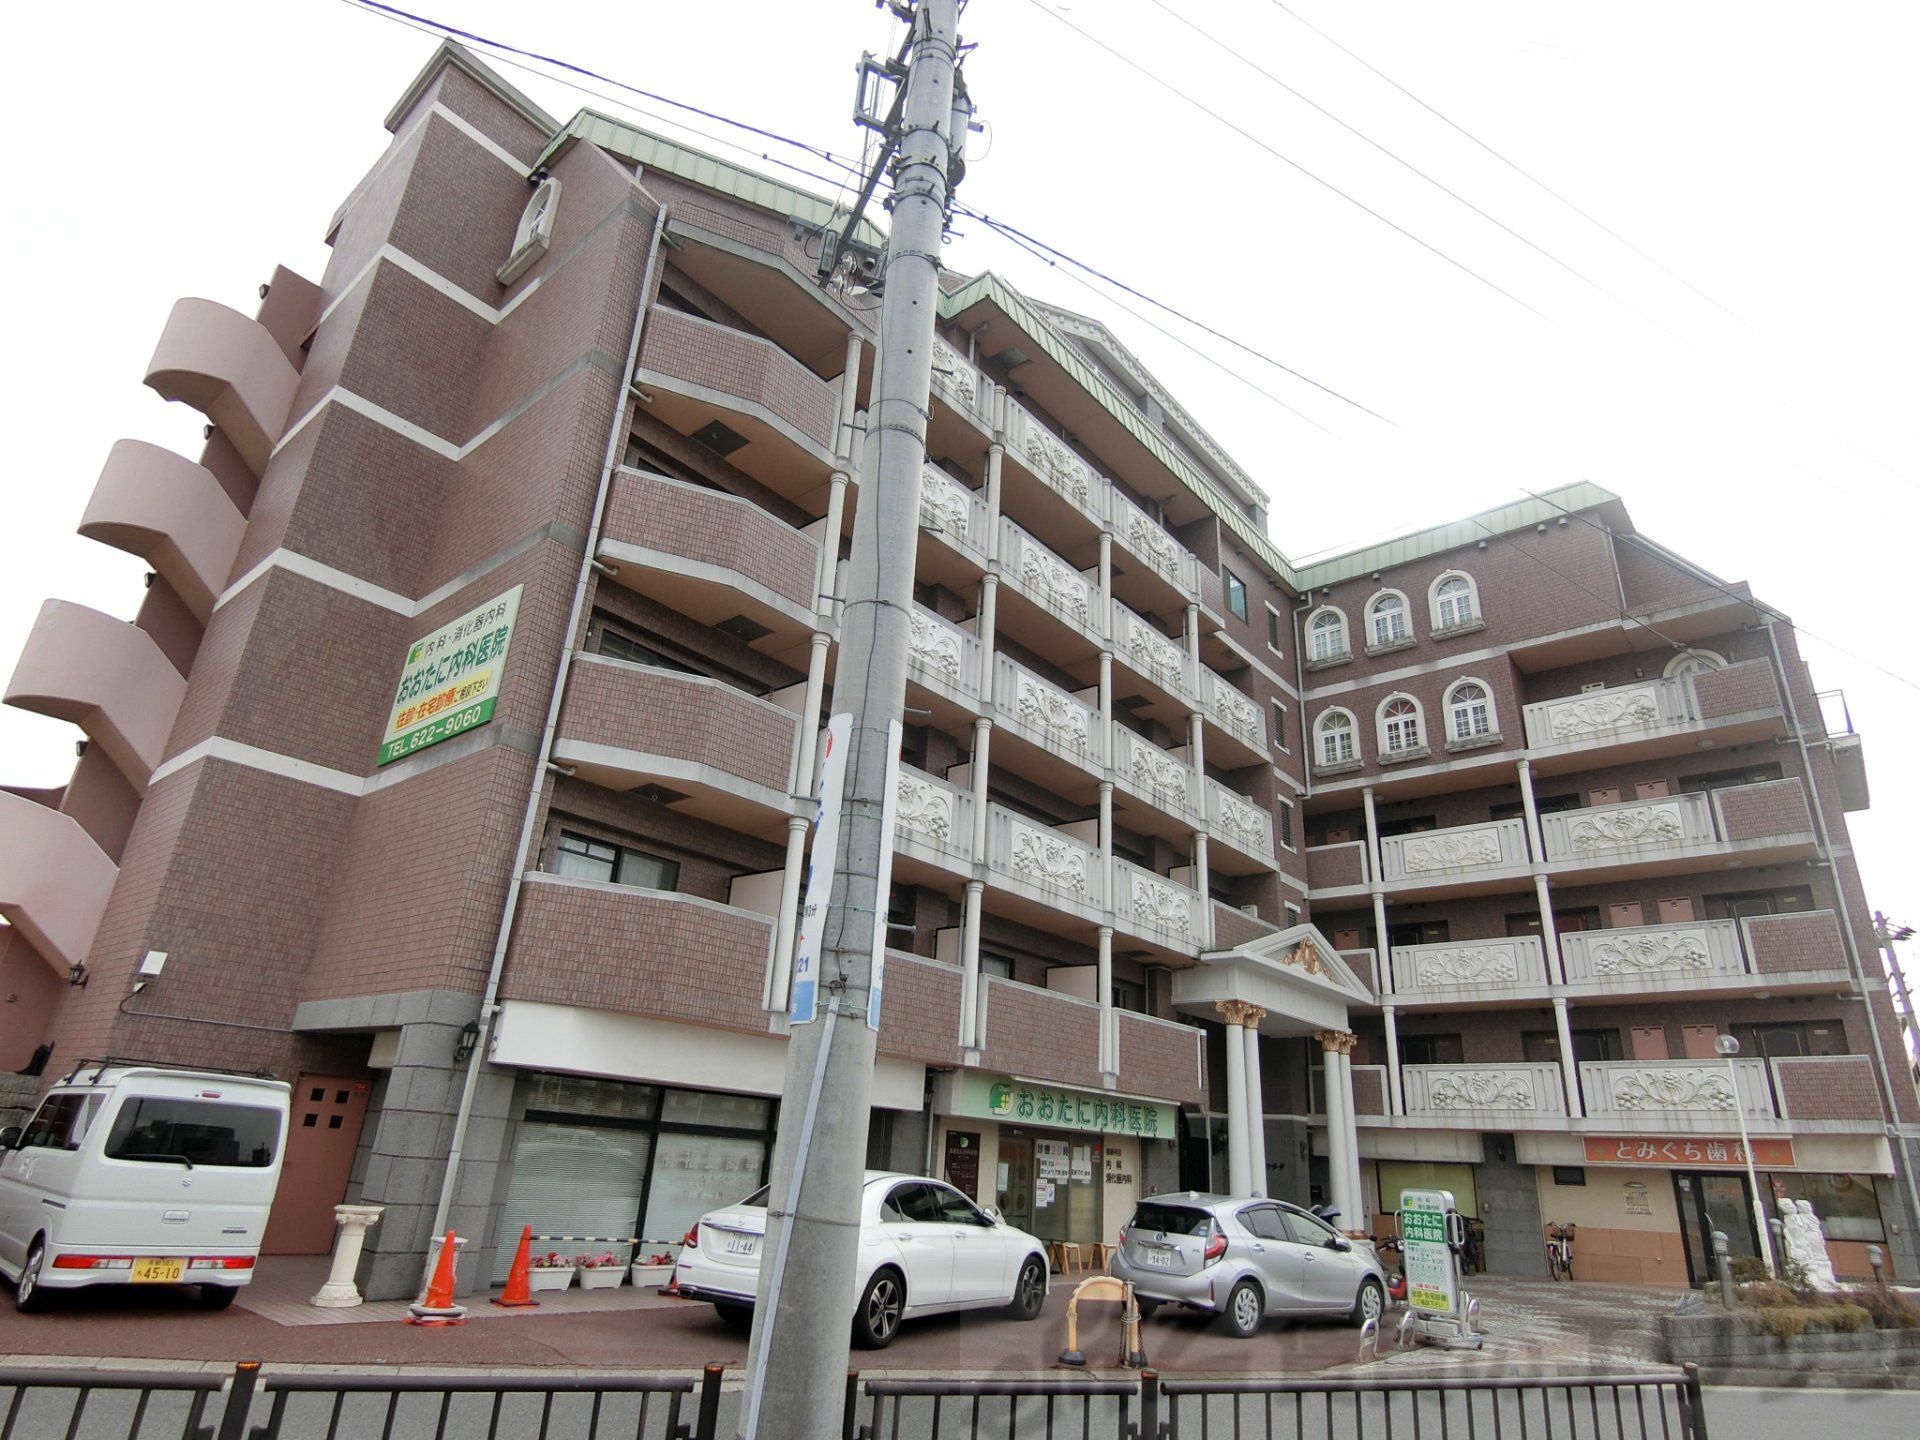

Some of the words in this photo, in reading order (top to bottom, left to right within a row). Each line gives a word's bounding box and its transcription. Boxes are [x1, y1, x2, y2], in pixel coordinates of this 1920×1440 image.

[397, 624, 509, 704] おおたに内科医院
[410, 706, 482, 749] 622-9060
[1017, 1088, 1158, 1134] おおたに内科医院
[1616, 1141, 1755, 1162] とみぐち歯科
[1403, 1212, 1443, 1227] おおたに
[1404, 1226, 1443, 1241] 内科医院
[143, 1267, 180, 1280] 45-10
